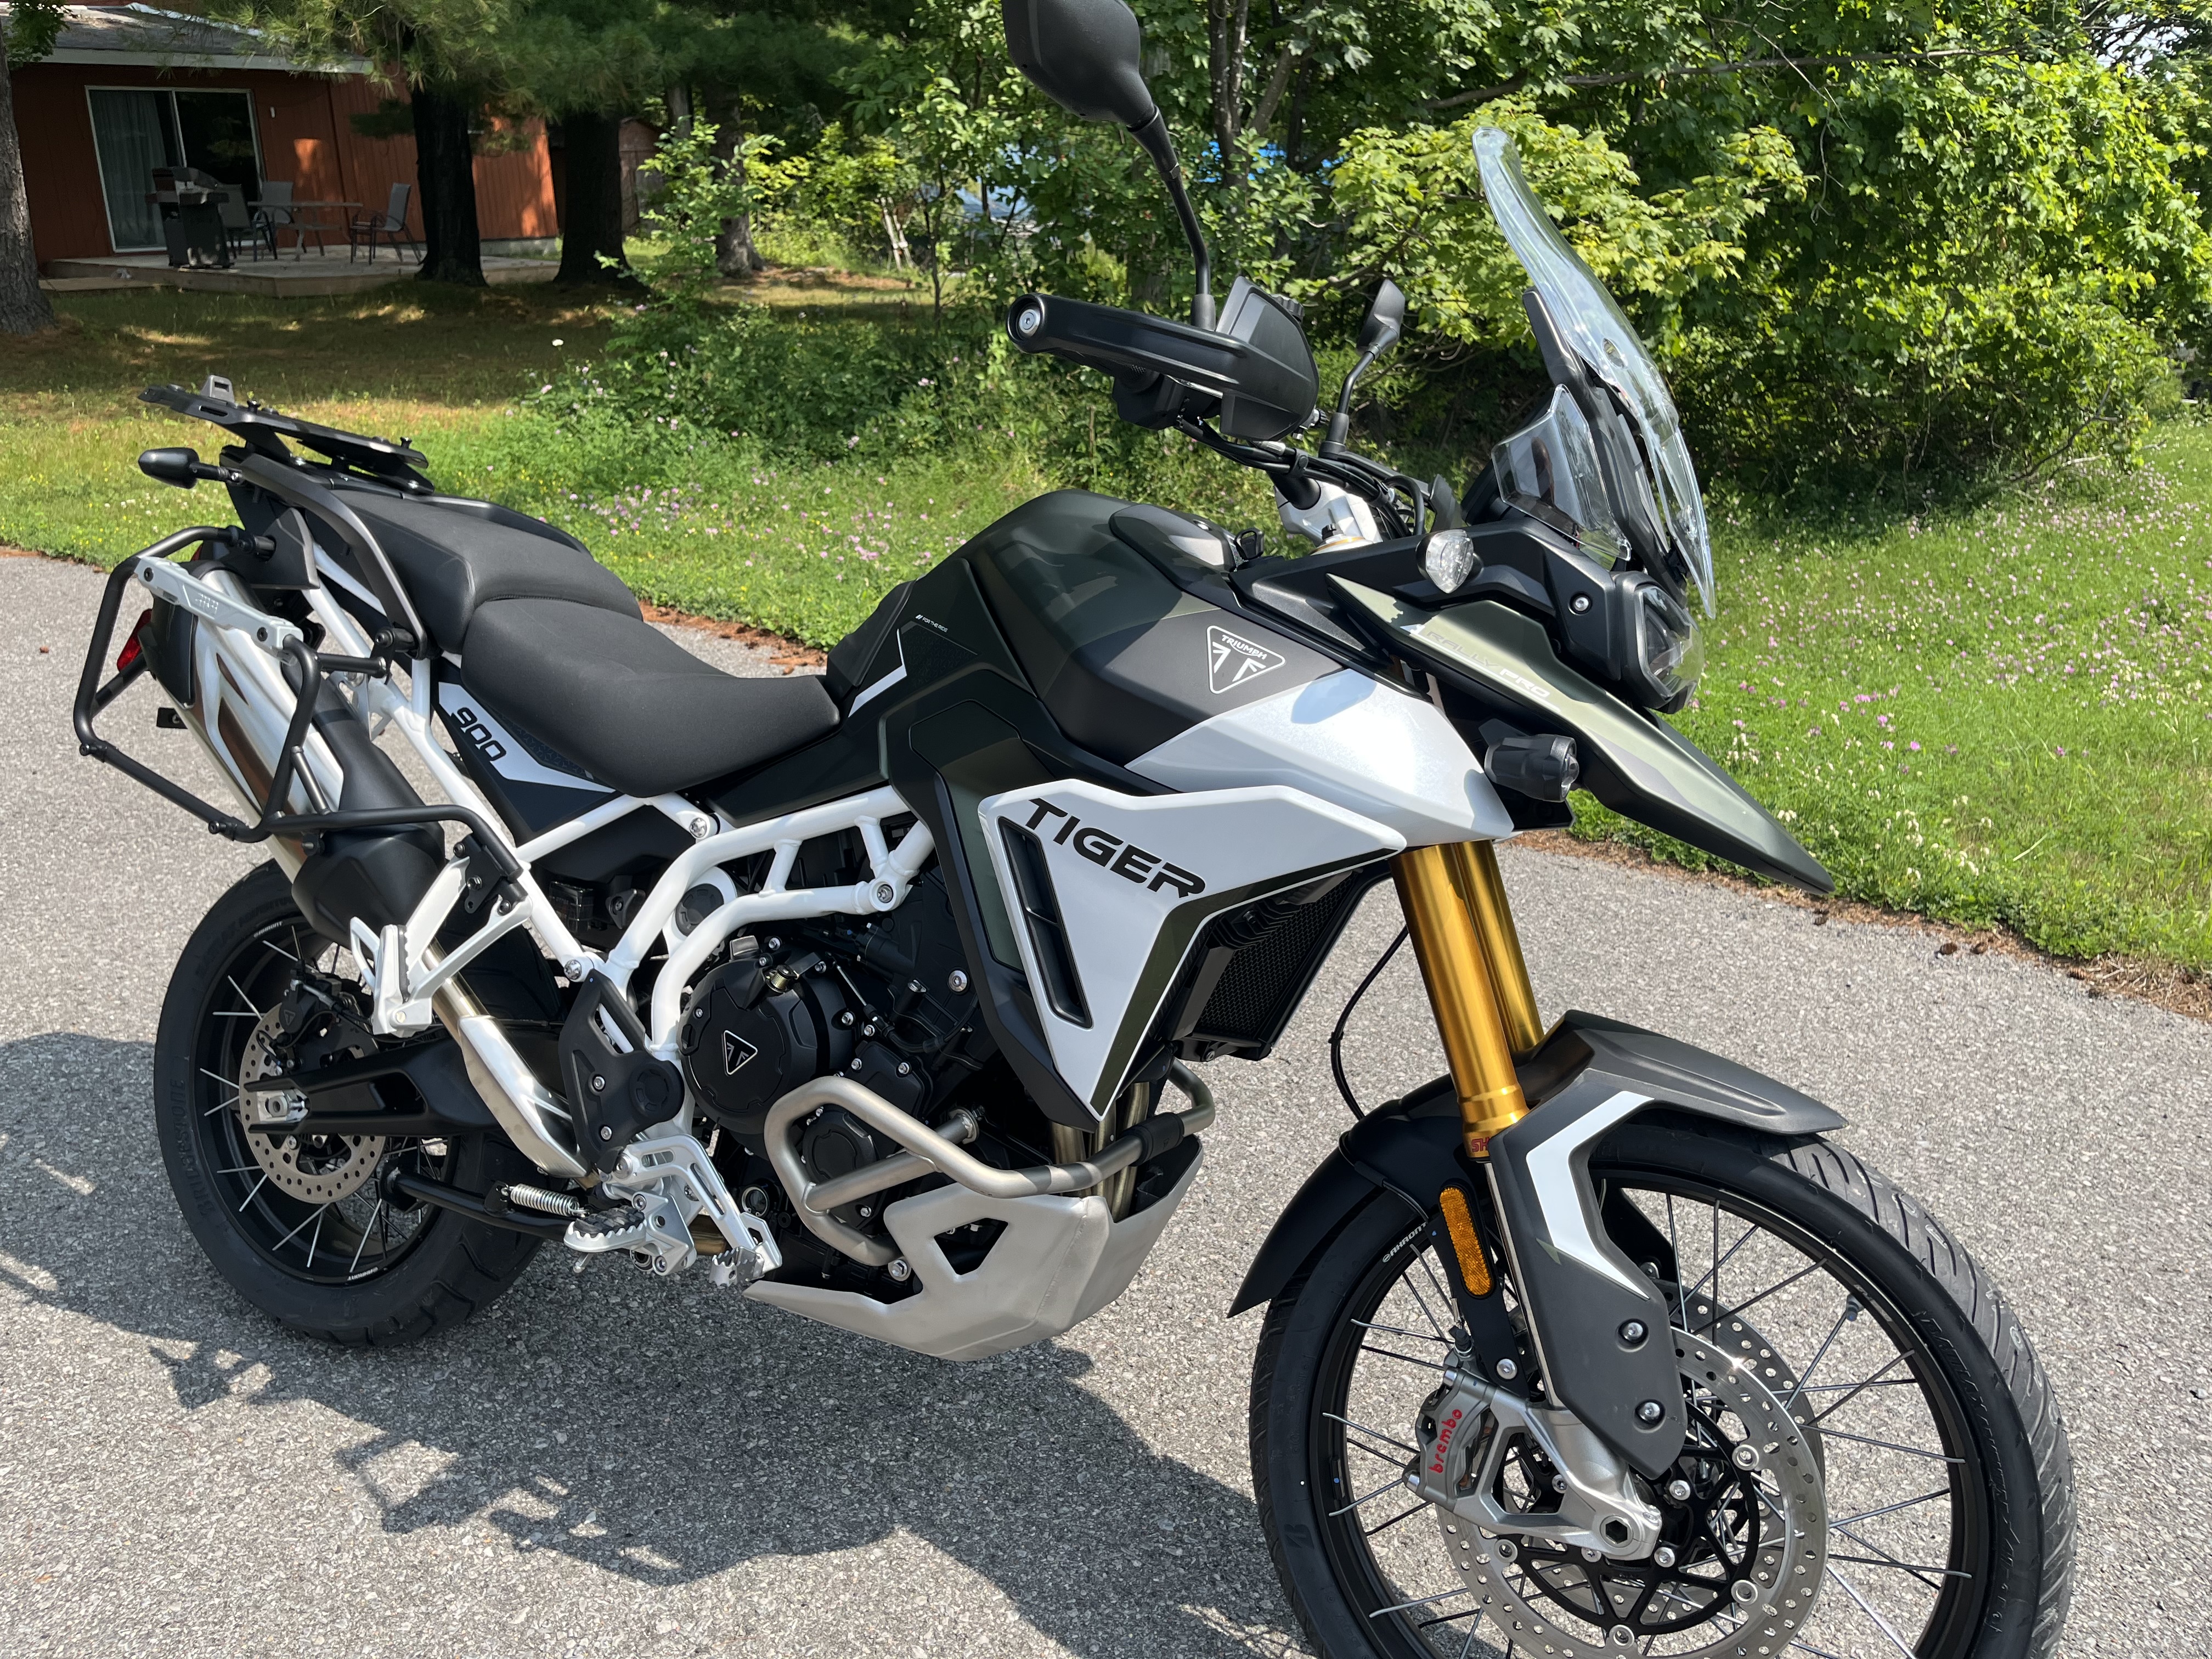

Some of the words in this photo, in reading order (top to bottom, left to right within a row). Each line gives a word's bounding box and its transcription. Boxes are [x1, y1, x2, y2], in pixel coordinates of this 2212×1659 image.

[1222, 634, 1267, 660] TRIUMPH
[1426, 631, 1499, 667] RALLY
[1499, 668, 1550, 698] PRO
[450, 707, 507, 762] 900
[1025, 797, 1206, 899] TIGER
[1428, 1409, 1462, 1474] brembo
